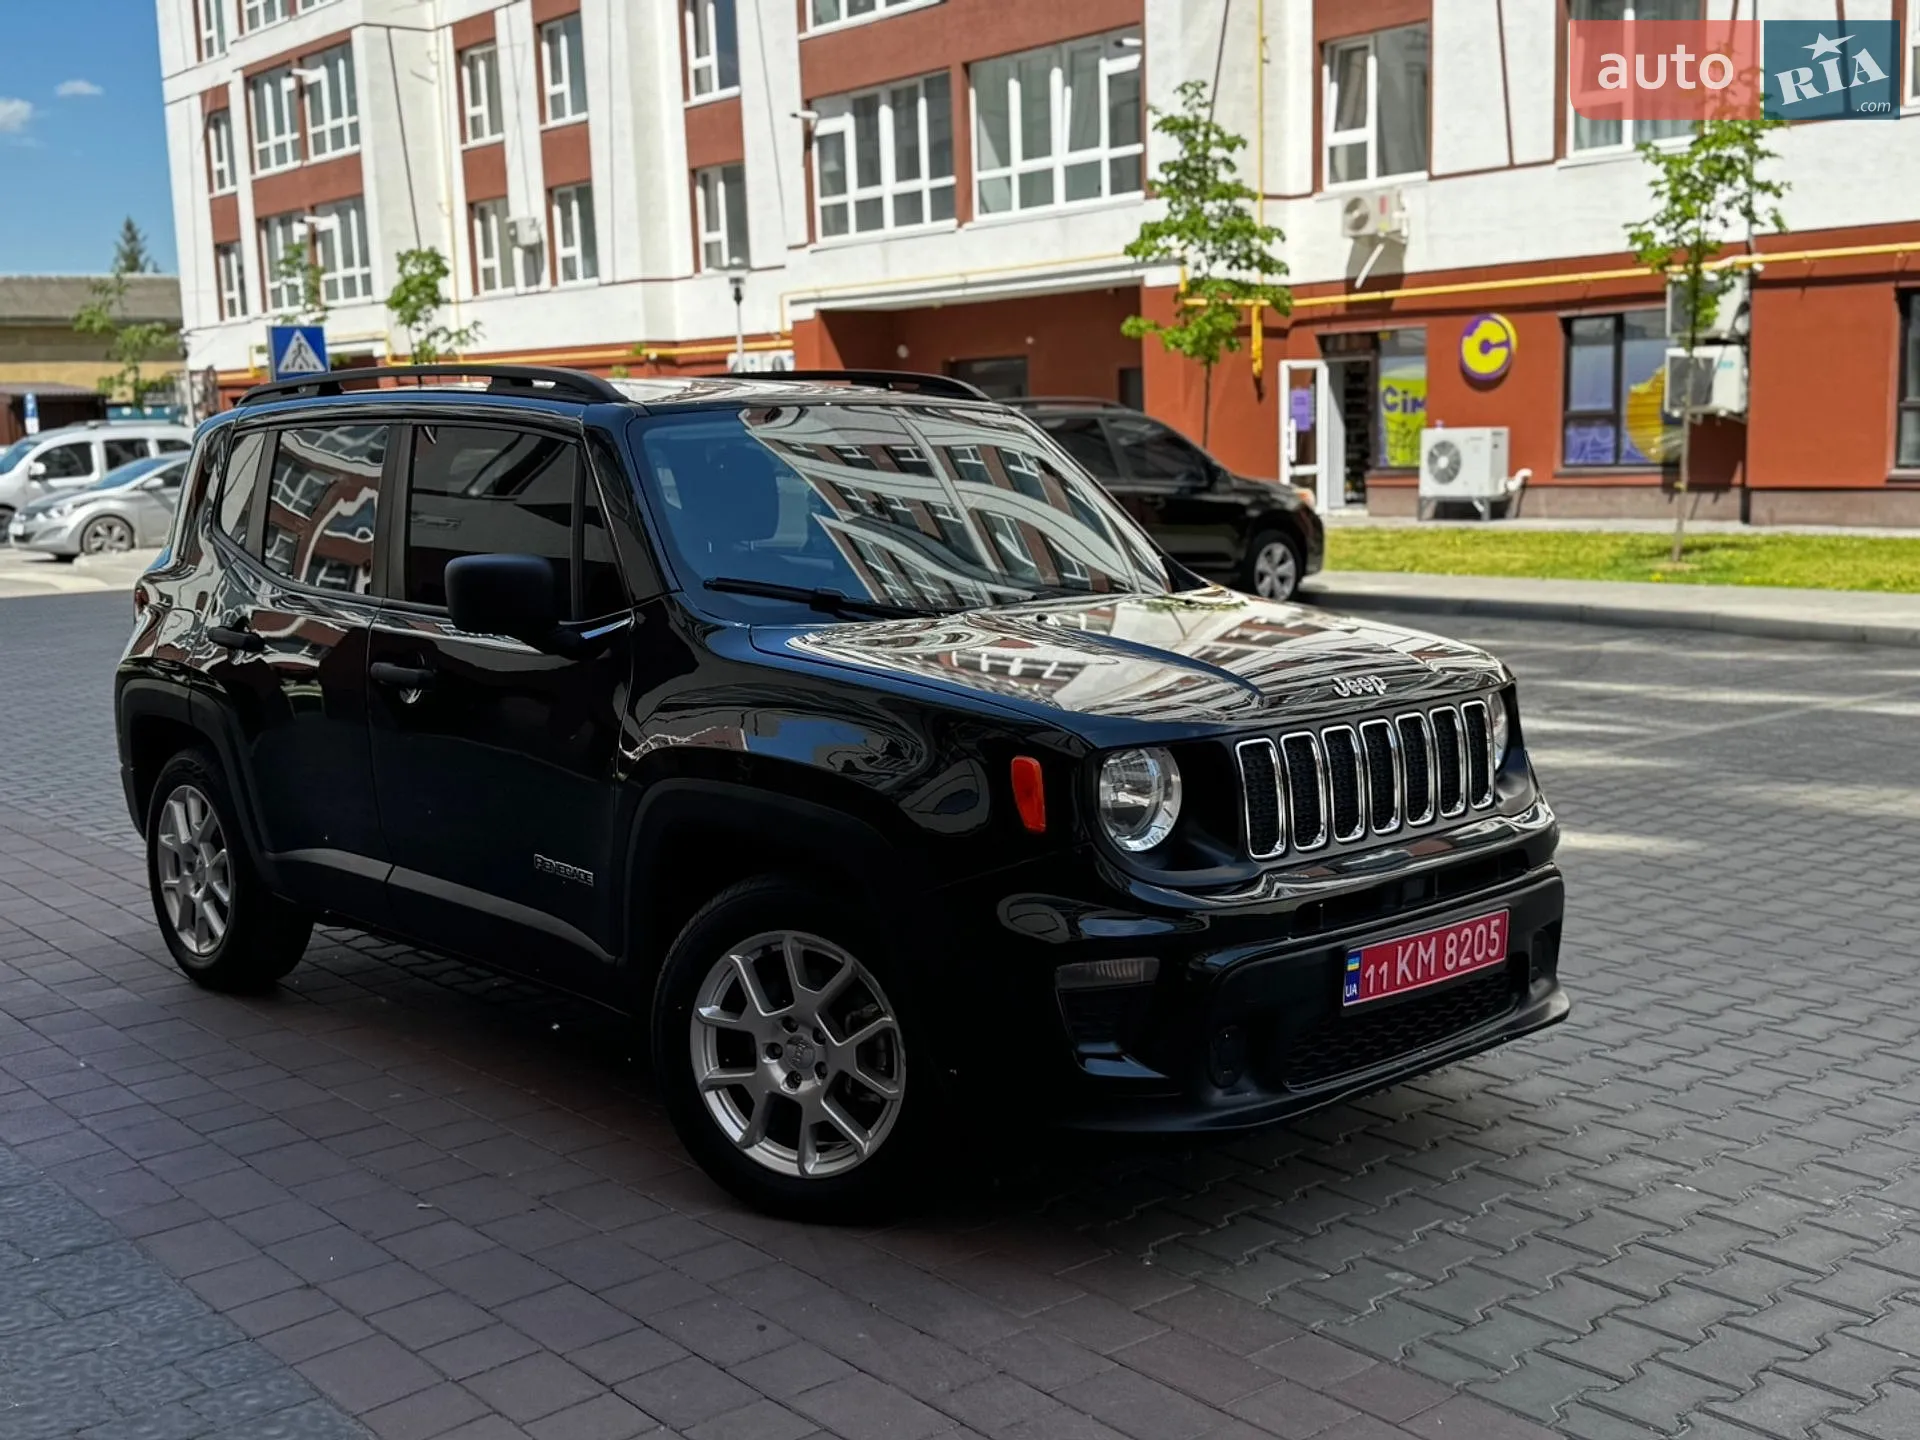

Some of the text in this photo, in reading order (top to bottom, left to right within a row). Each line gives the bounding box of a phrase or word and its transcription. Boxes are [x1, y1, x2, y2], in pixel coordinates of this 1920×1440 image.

[1331, 675, 1388, 698] Jeep
[1364, 919, 1501, 994] 11 KM 8205
[1345, 983, 1358, 997] UA
